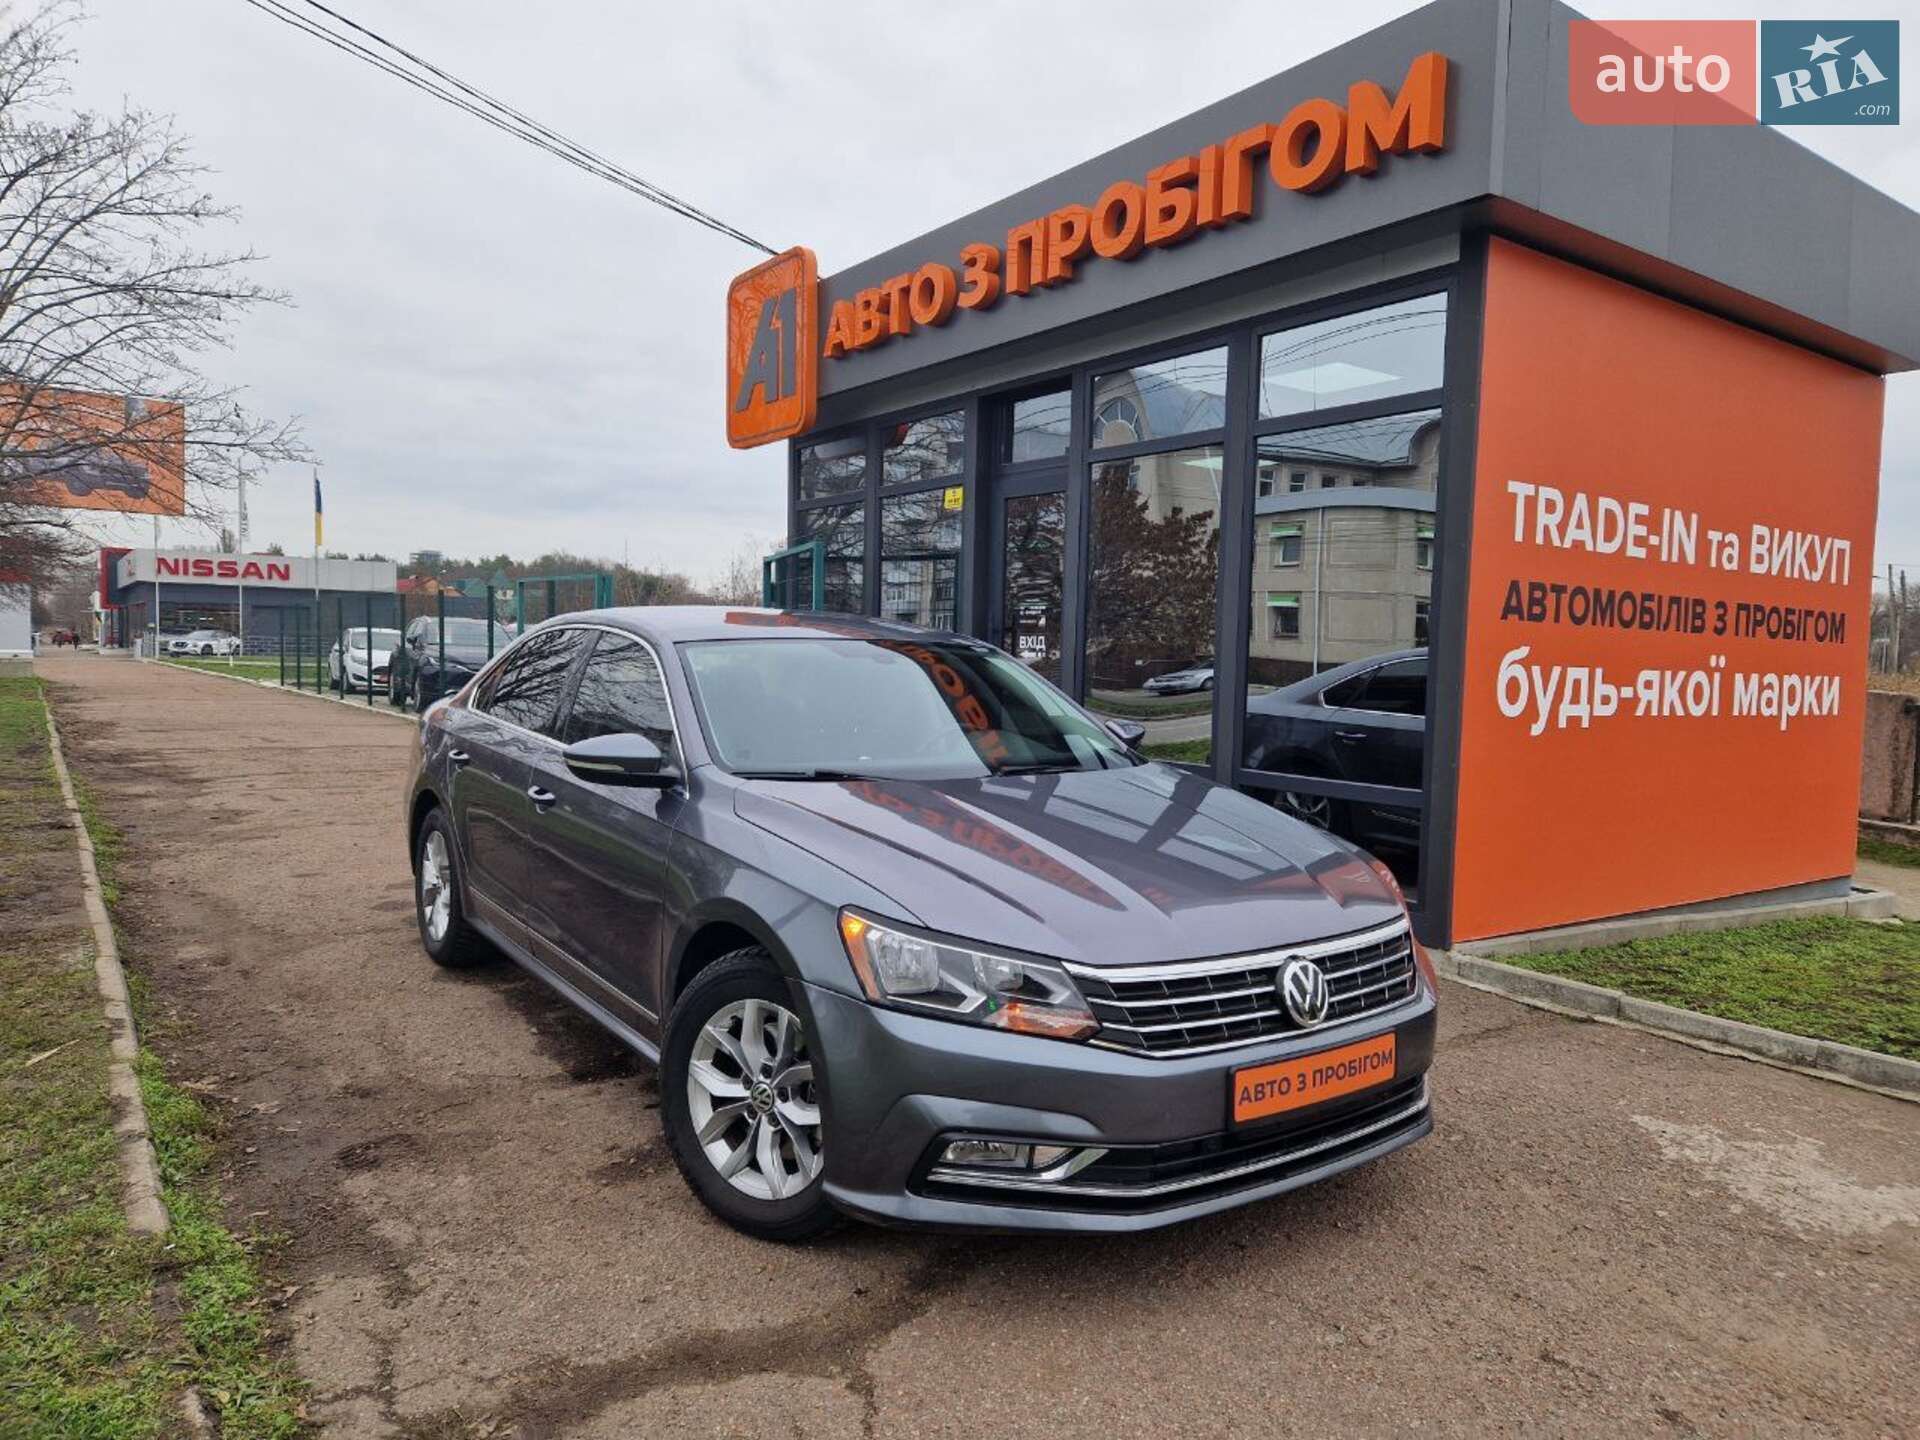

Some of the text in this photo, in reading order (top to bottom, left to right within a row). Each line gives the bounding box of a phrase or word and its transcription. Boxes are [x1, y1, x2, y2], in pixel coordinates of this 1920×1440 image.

[823, 262, 956, 359] АВТО
[1006, 50, 1447, 296] ПРОБІГОМ
[1507, 480, 1851, 586] TRADE-IN та ВИКУП
[156, 557, 290, 581] NISSAN
[1020, 635, 1046, 651] ВХІД
[1500, 580, 1706, 634] АВТОМОБІЛІВ
[1734, 603, 1846, 644] ПРОБІГОМ
[1496, 645, 1840, 736] будь-якої марки
[1239, 1076, 1291, 1105] АВТО
[1312, 1047, 1393, 1088] ПРОБІГОМ
